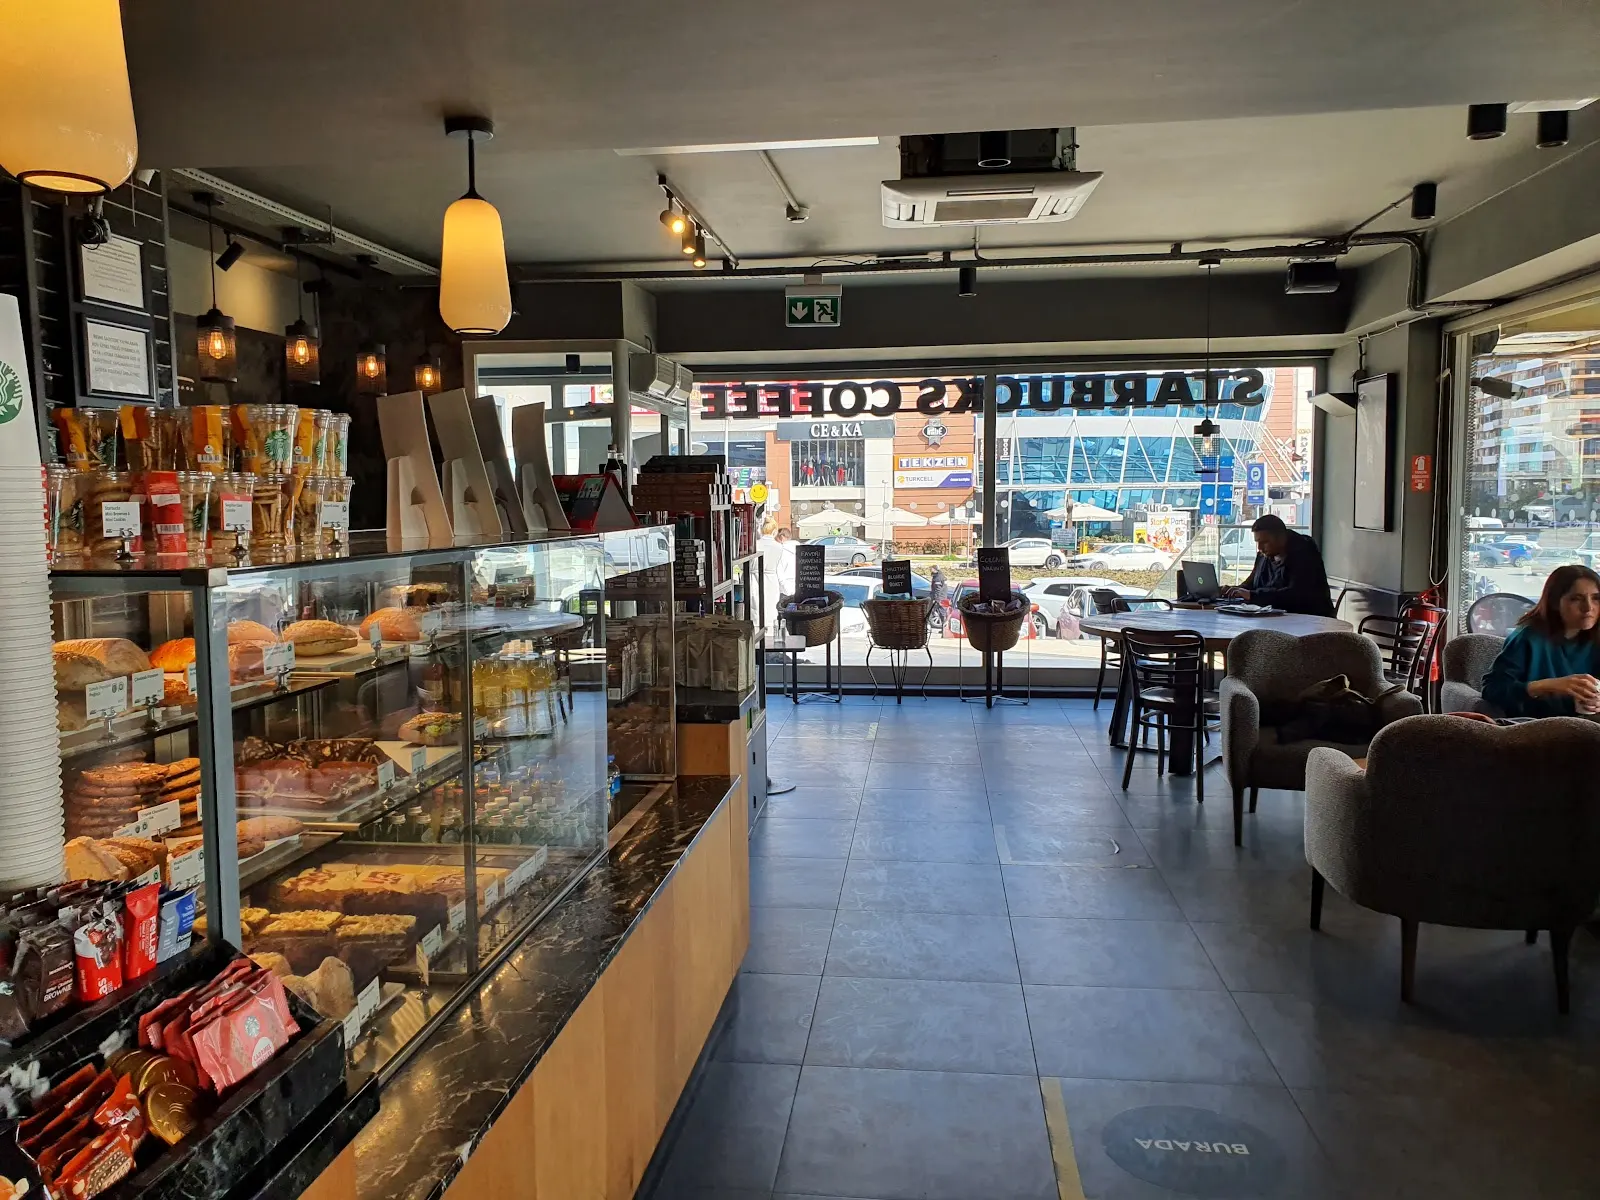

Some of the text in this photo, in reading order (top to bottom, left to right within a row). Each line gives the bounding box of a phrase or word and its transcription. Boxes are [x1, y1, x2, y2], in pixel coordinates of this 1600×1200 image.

[899, 456, 968, 468] TEKZEN
[43, 984, 73, 1002] BROWNIE
[1134, 1138, 1250, 1155] BURADA
